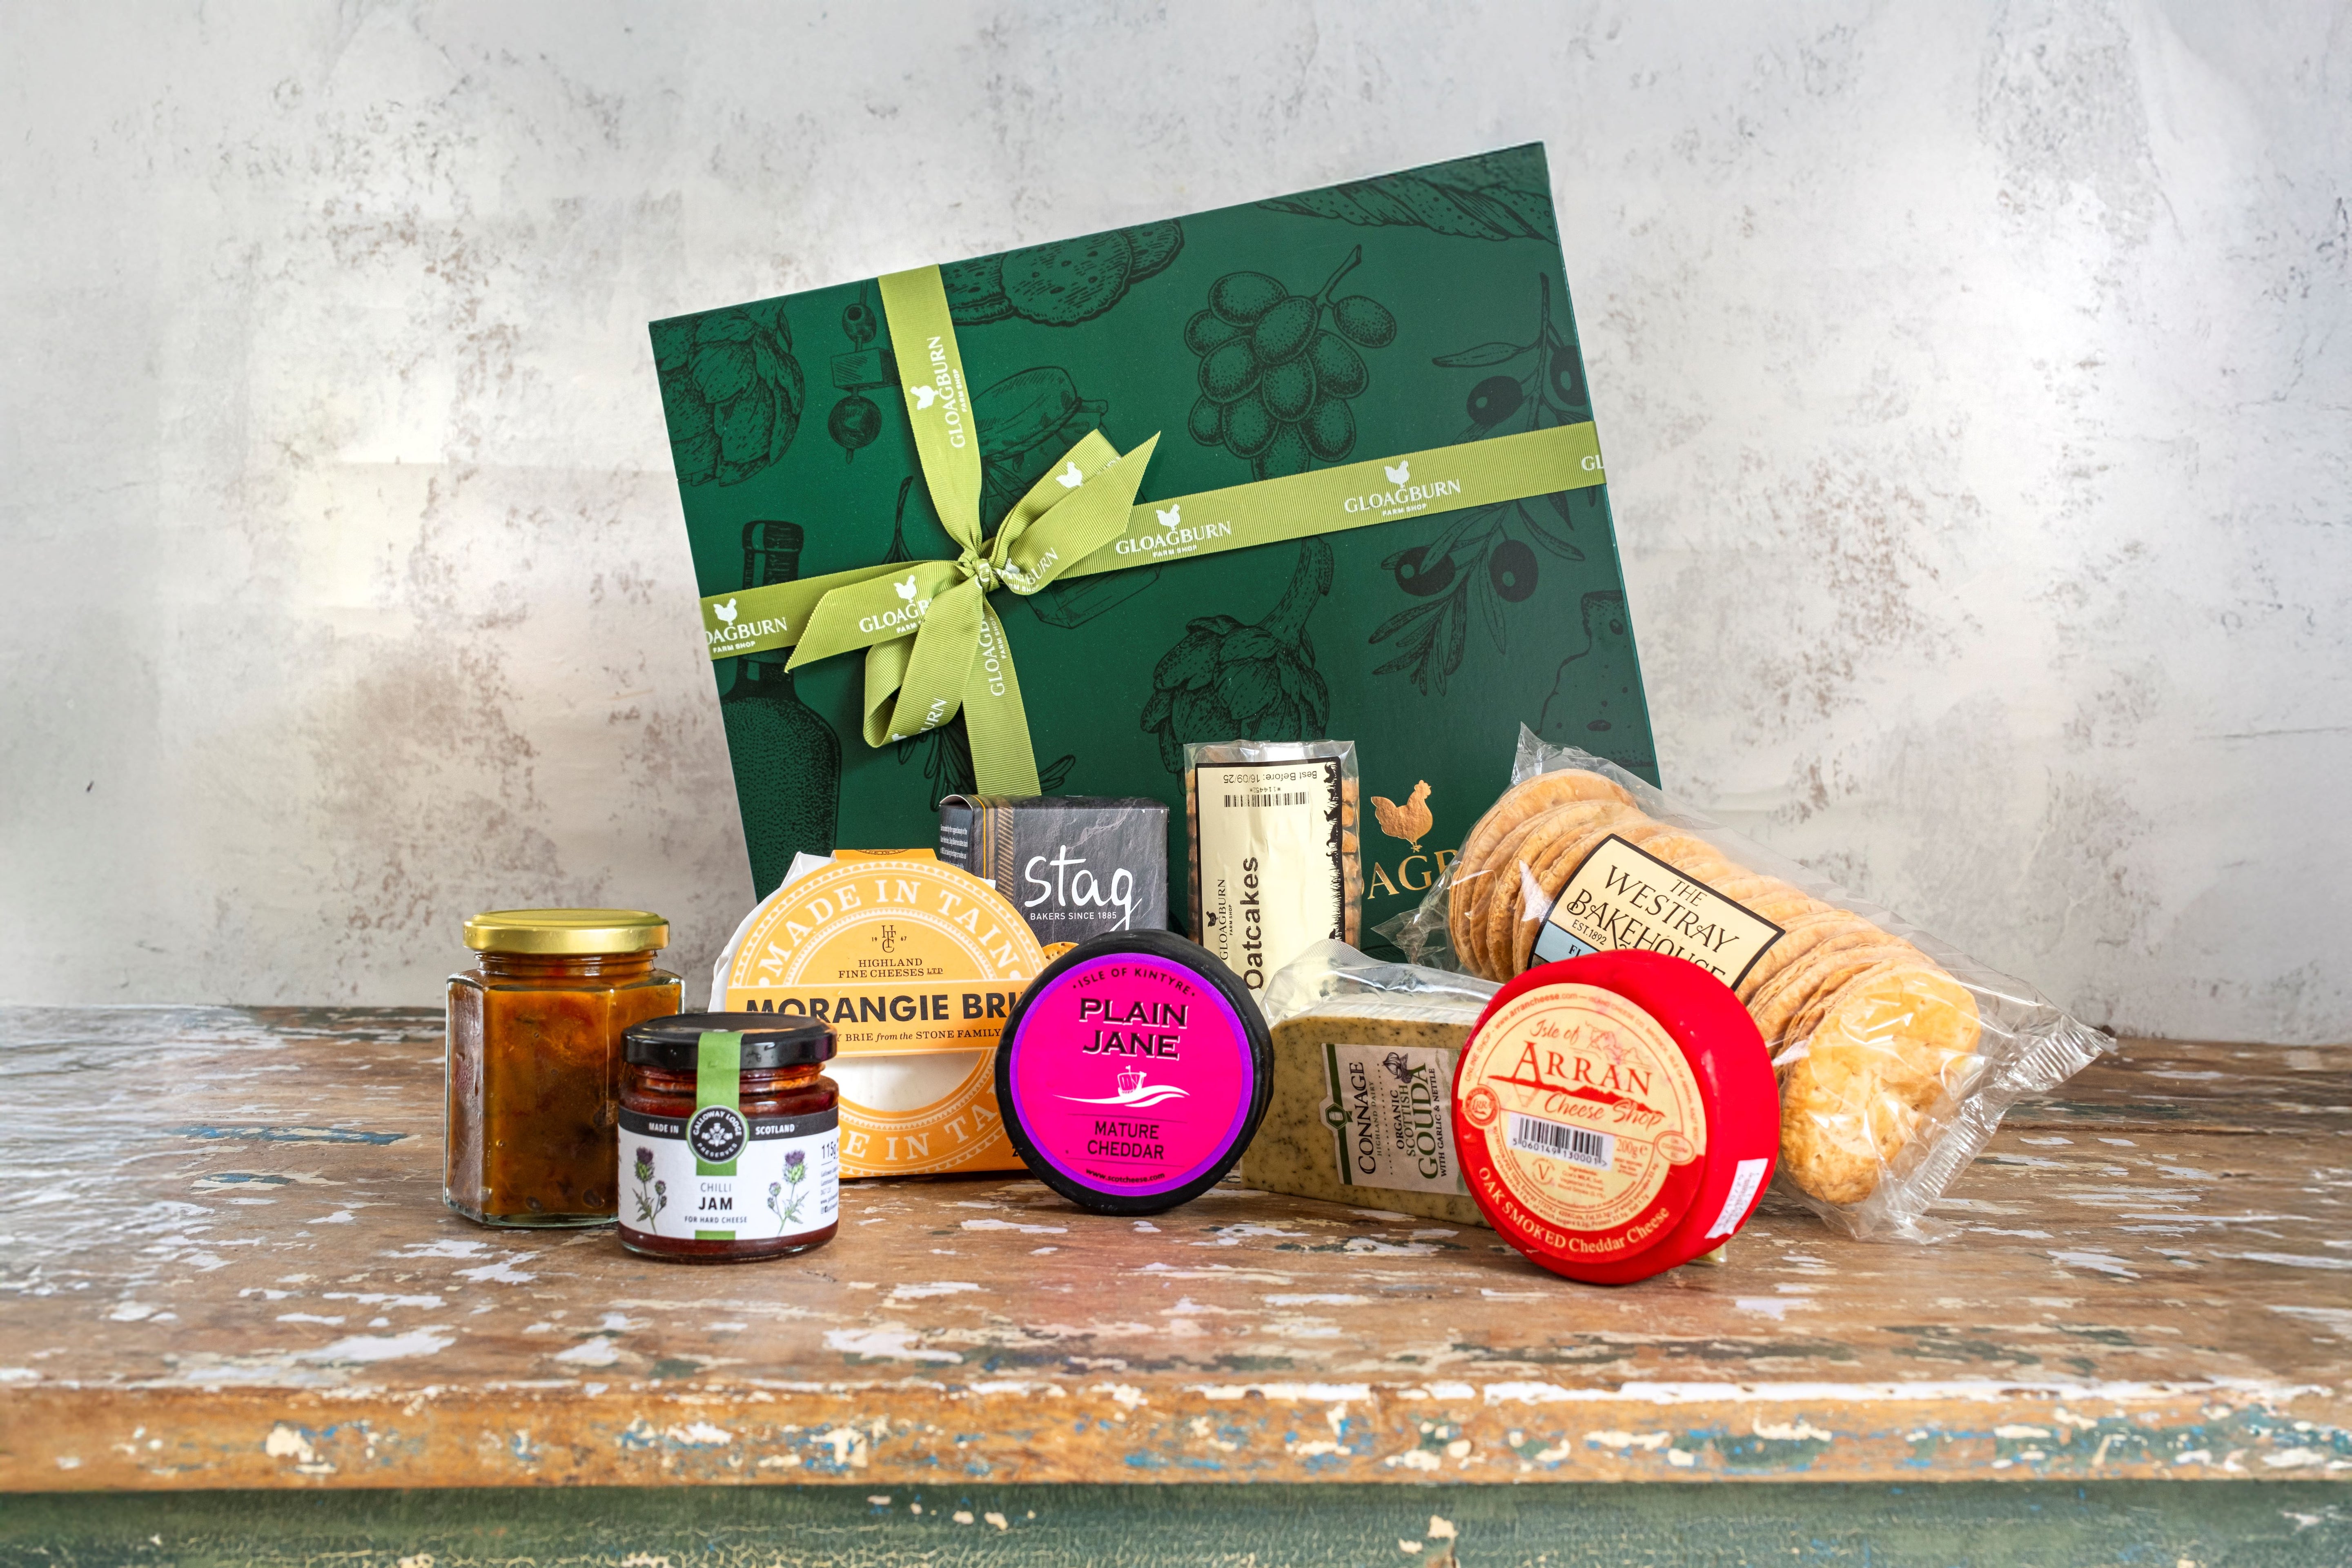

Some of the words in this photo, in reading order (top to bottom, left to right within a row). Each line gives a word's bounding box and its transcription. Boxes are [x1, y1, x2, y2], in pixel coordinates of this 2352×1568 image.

[927, 336, 965, 448] GLOAGBURN
[953, 369, 962, 390] SHOP
[958, 390, 967, 412] FARM
[1344, 479, 1461, 513] GLOAGBURN
[1383, 507, 1405, 516] FARM
[1406, 504, 1426, 512] SHOP
[1116, 521, 1231, 554] GLOAGBURN
[1153, 548, 1174, 558] FARM
[1177, 545, 1197, 554] SHOP
[859, 598, 932, 632] GLOAGB
[989, 616, 1000, 635] SHOP
[897, 623, 917, 633] FARM
[713, 644, 734, 653] FARM
[735, 641, 755, 649] SHOP
[997, 637, 1007, 659] FARM
[1223, 774, 1260, 783] 16/09/25
[1263, 773, 1296, 781] Before:
[1300, 771, 1317, 779] Best
[1670, 879, 1707, 906] THE
[1217, 879, 1228, 960] GLOAGBURN
[1605, 864, 1740, 953] WESTRAY
[758, 884, 862, 977] MADE
[875, 879, 921, 904] IN
[938, 889, 1020, 969] TAIN
[1240, 857, 1264, 990] Oatcakes
[1572, 919, 1607, 945] EST.1892
[858, 958, 922, 967] HIGHLAND
[870, 969, 924, 978] CHEESES
[1078, 971, 1105, 988] ISLE
[1111, 968, 1127, 977] OF
[1135, 968, 1191, 995] KINTYRE
[746, 994, 949, 1024] MORANGIE
[963, 991, 1022, 1020] BRI
[1079, 998, 1188, 1029] PLAIN
[846, 1033, 873, 1042] BRIE
[875, 1033, 898, 1042] from
[915, 1030, 954, 1039] STONE
[957, 1029, 1001, 1038] FAMILY
[1465, 1053, 1479, 1081] ONLINE
[1477, 1031, 1491, 1052] SHOP
[1495, 993, 1578, 1029] www.arrancheese.com
[1530, 1019, 1559, 1038] Isle
[1564, 1026, 1580, 1045] of
[1082, 1030, 1180, 1061] JANE
[1512, 1040, 1653, 1096] ARRAN
[1429, 1068, 1439, 1102] NETTLE
[693, 1111, 726, 1136] GALLOWAY
[726, 1113, 742, 1136] LODGE
[1349, 1062, 1376, 1174] CONNAGE
[1390, 1090, 1405, 1149] ORGANIC
[1399, 1085, 1416, 1157] SCOTTISH
[1409, 1063, 1438, 1179] GOUDA
[1544, 1091, 1605, 1120] Cheese
[1613, 1098, 1662, 1131] Shop
[649, 1122, 668, 1132] MADE
[670, 1125, 679, 1134] IN
[755, 1124, 795, 1136] SCOTLAND
[1095, 1121, 1159, 1139] MATURE
[1373, 1111, 1382, 1156] HIGHLAND
[1435, 1114, 1444, 1149] GARLIC
[697, 1143, 737, 1158] PRESERVES
[822, 1141, 836, 1159] 115g
[885, 1132, 930, 1161] IN
[1087, 1140, 1164, 1160] CHEDDAR
[1522, 1140, 1556, 1154] 060149
[1564, 1150, 1597, 1165] 130001
[1616, 1138, 1638, 1158] 200g
[1086, 1169, 1165, 1183] www.scotcheese.com
[1438, 1152, 1447, 1177] WITH
[1539, 1163, 1550, 1180] V
[701, 1183, 731, 1192] CHILLI
[699, 1196, 732, 1210] JAM
[1479, 1167, 1506, 1205] OAK
[1502, 1201, 1566, 1249] SMOKED
[1569, 1237, 1624, 1253] Cheddar
[1627, 1207, 1669, 1243] Cheese
